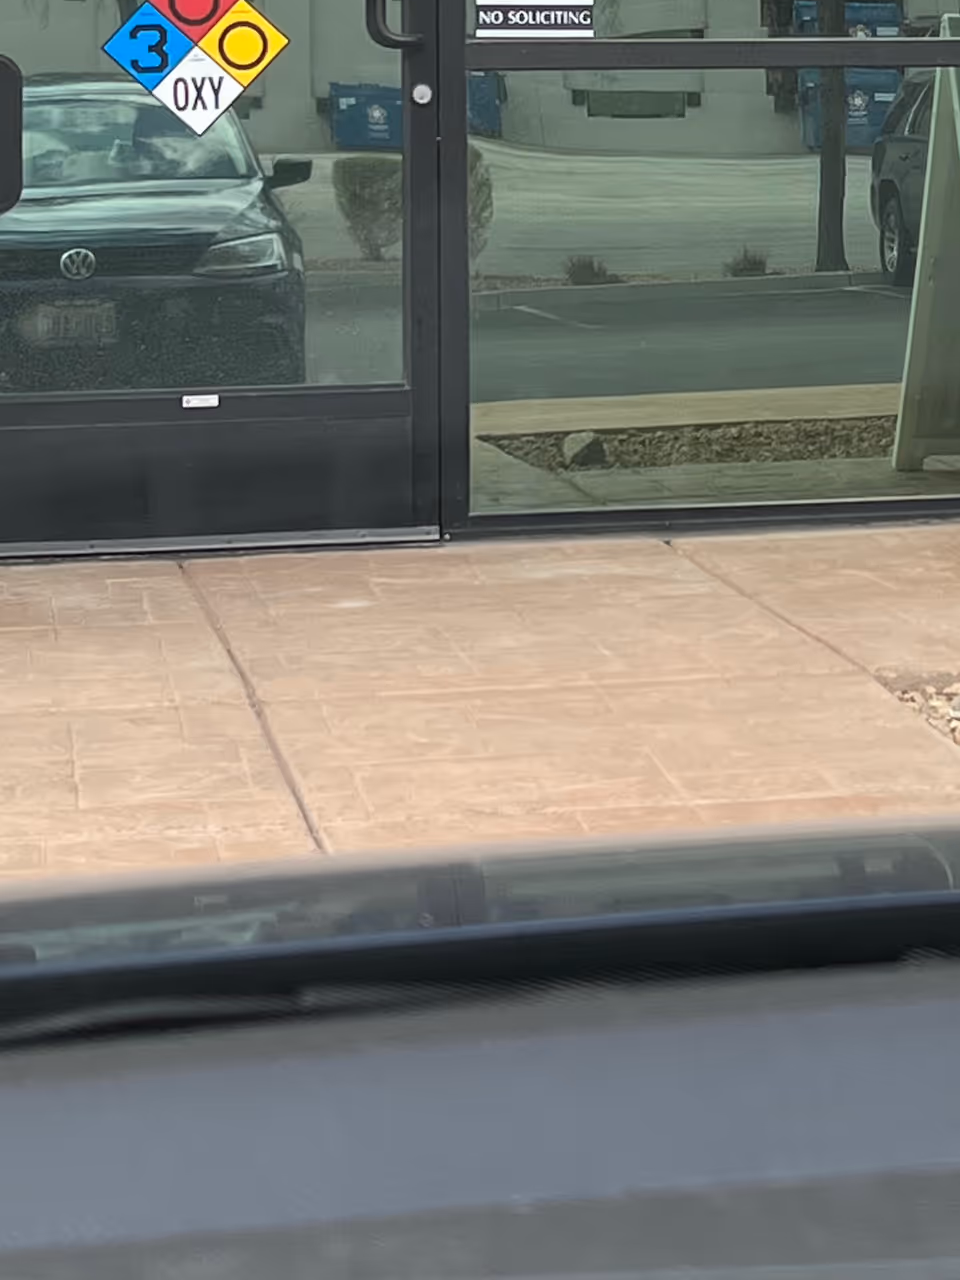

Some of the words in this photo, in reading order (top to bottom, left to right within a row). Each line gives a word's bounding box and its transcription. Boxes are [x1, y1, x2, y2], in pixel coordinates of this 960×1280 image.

[479, 10, 504, 25] NO
[507, 10, 592, 25] SOLICITING
[129, 23, 169, 74] 3
[173, 76, 224, 111] OXY
